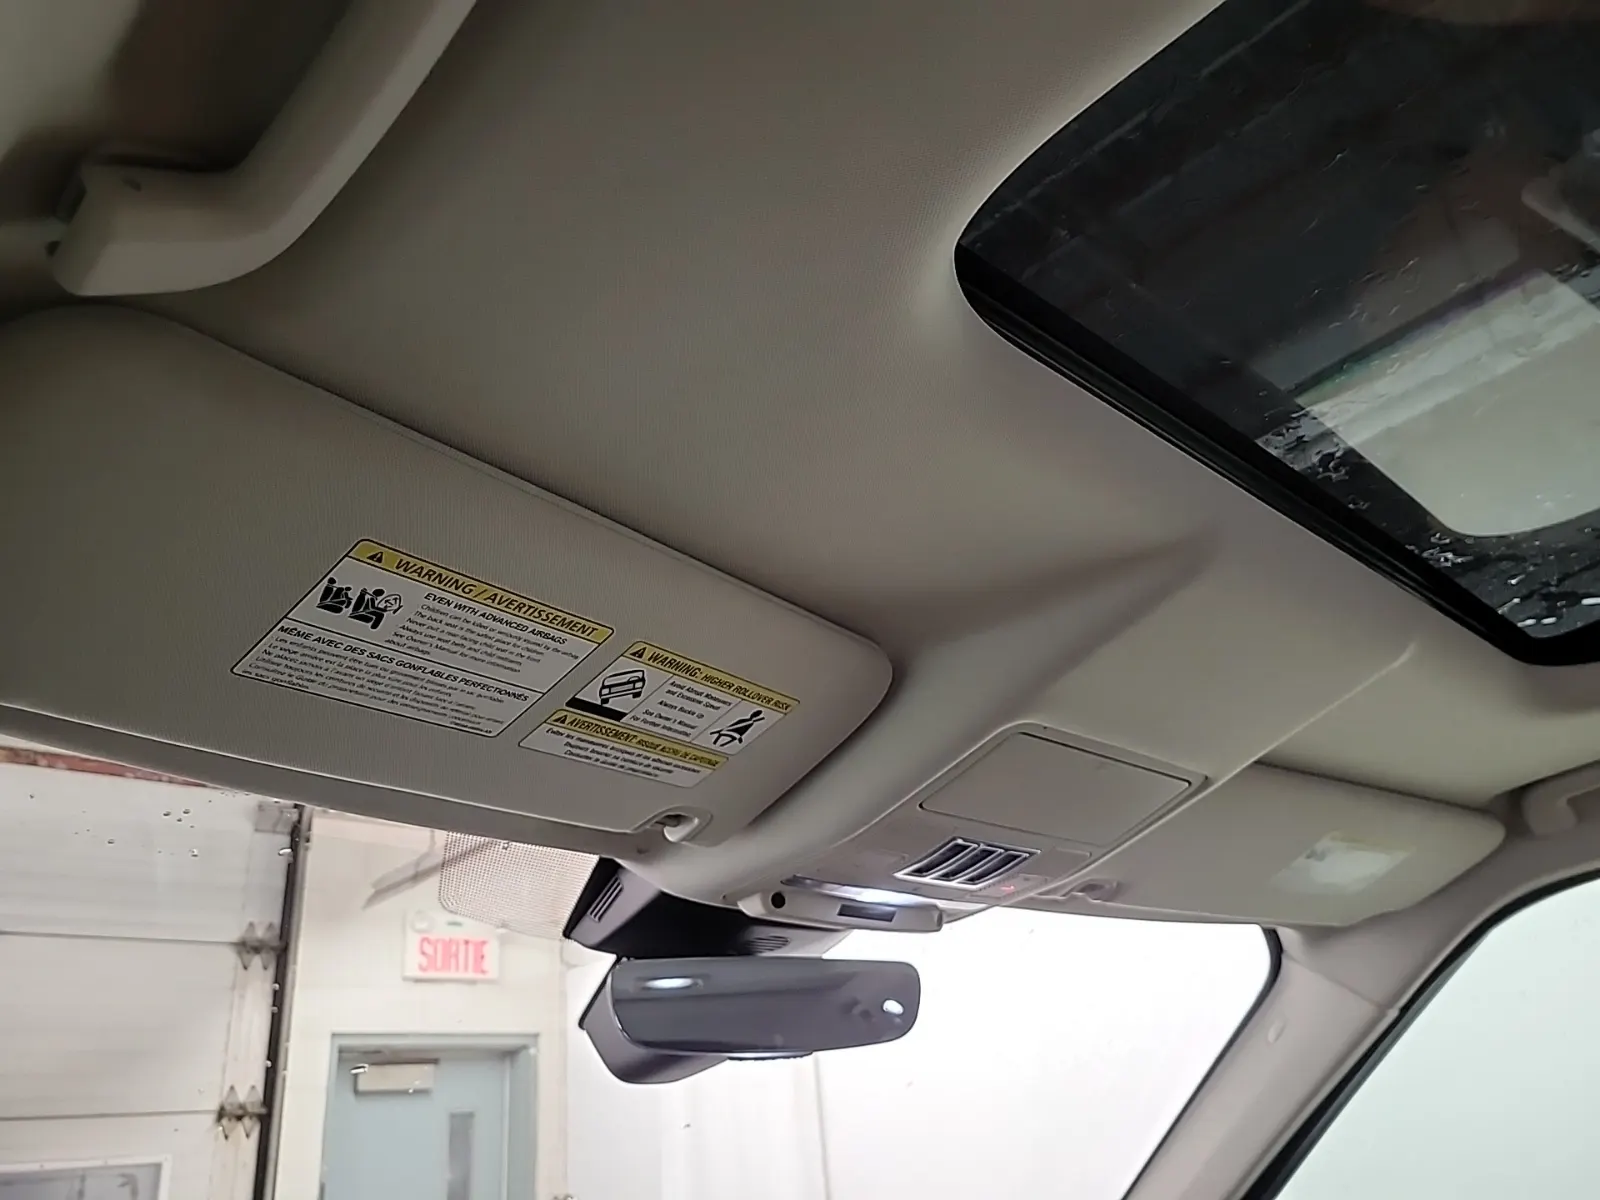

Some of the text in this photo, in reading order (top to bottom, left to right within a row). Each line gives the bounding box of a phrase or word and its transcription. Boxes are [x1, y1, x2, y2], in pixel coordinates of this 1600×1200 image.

[391, 558, 478, 594] WARNING
[482, 591, 599, 637] AVERTISSEMENT
[422, 592, 569, 644] EVEN WITH ADVANCED AIRBAGS
[276, 624, 316, 640] MÊME
[311, 635, 345, 649] AVEC
[341, 644, 368, 655] DES
[365, 651, 396, 664] SACS
[393, 659, 460, 682] GONFLABLES
[457, 676, 531, 701] PERFECTIONNÉS
[645, 651, 706, 678] WARNING:
[700, 673, 736, 690] HIGHER
[730, 684, 775, 704] ROLLOVER
[418, 936, 489, 975] SORTIE
